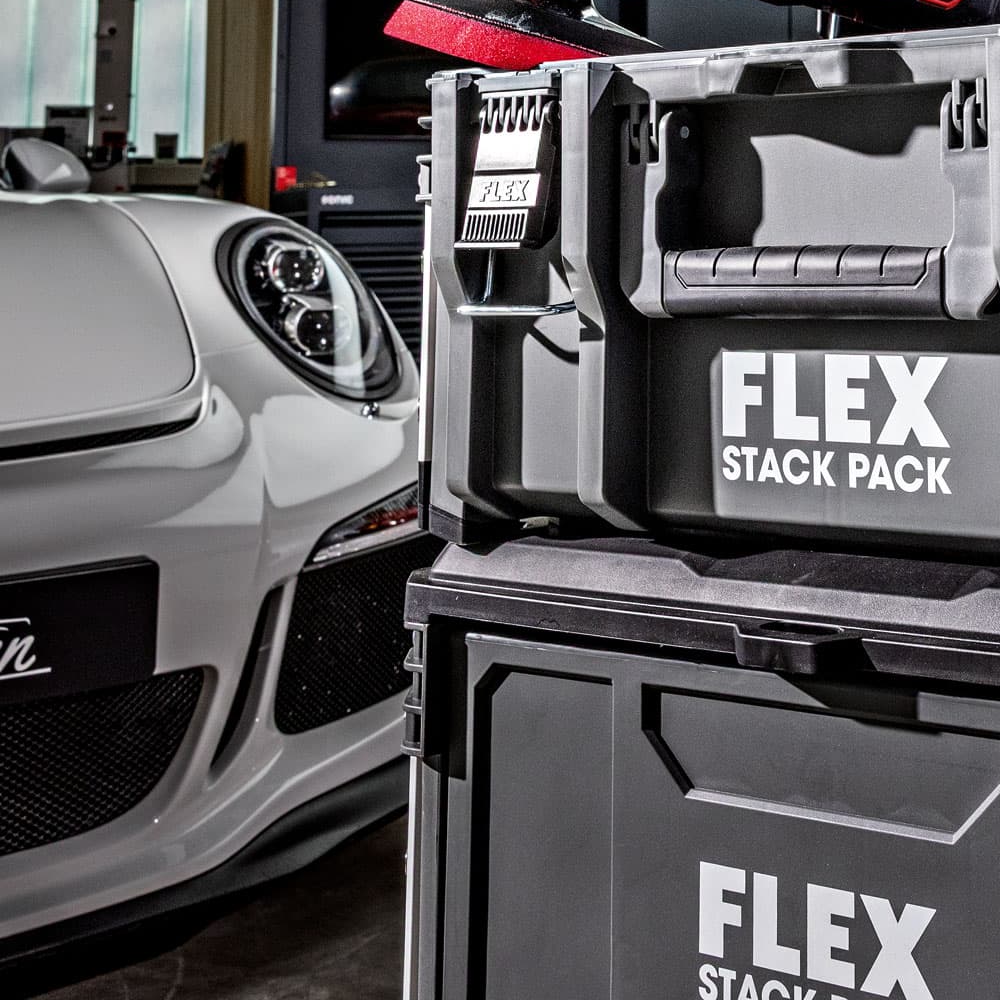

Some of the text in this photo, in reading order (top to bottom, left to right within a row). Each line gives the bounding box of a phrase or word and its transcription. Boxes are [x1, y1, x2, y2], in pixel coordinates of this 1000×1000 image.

[479, 180, 530, 202] FLEX
[722, 351, 951, 448] FLEX
[722, 445, 952, 495] STACK PACK
[699, 861, 936, 1000] FLEX
